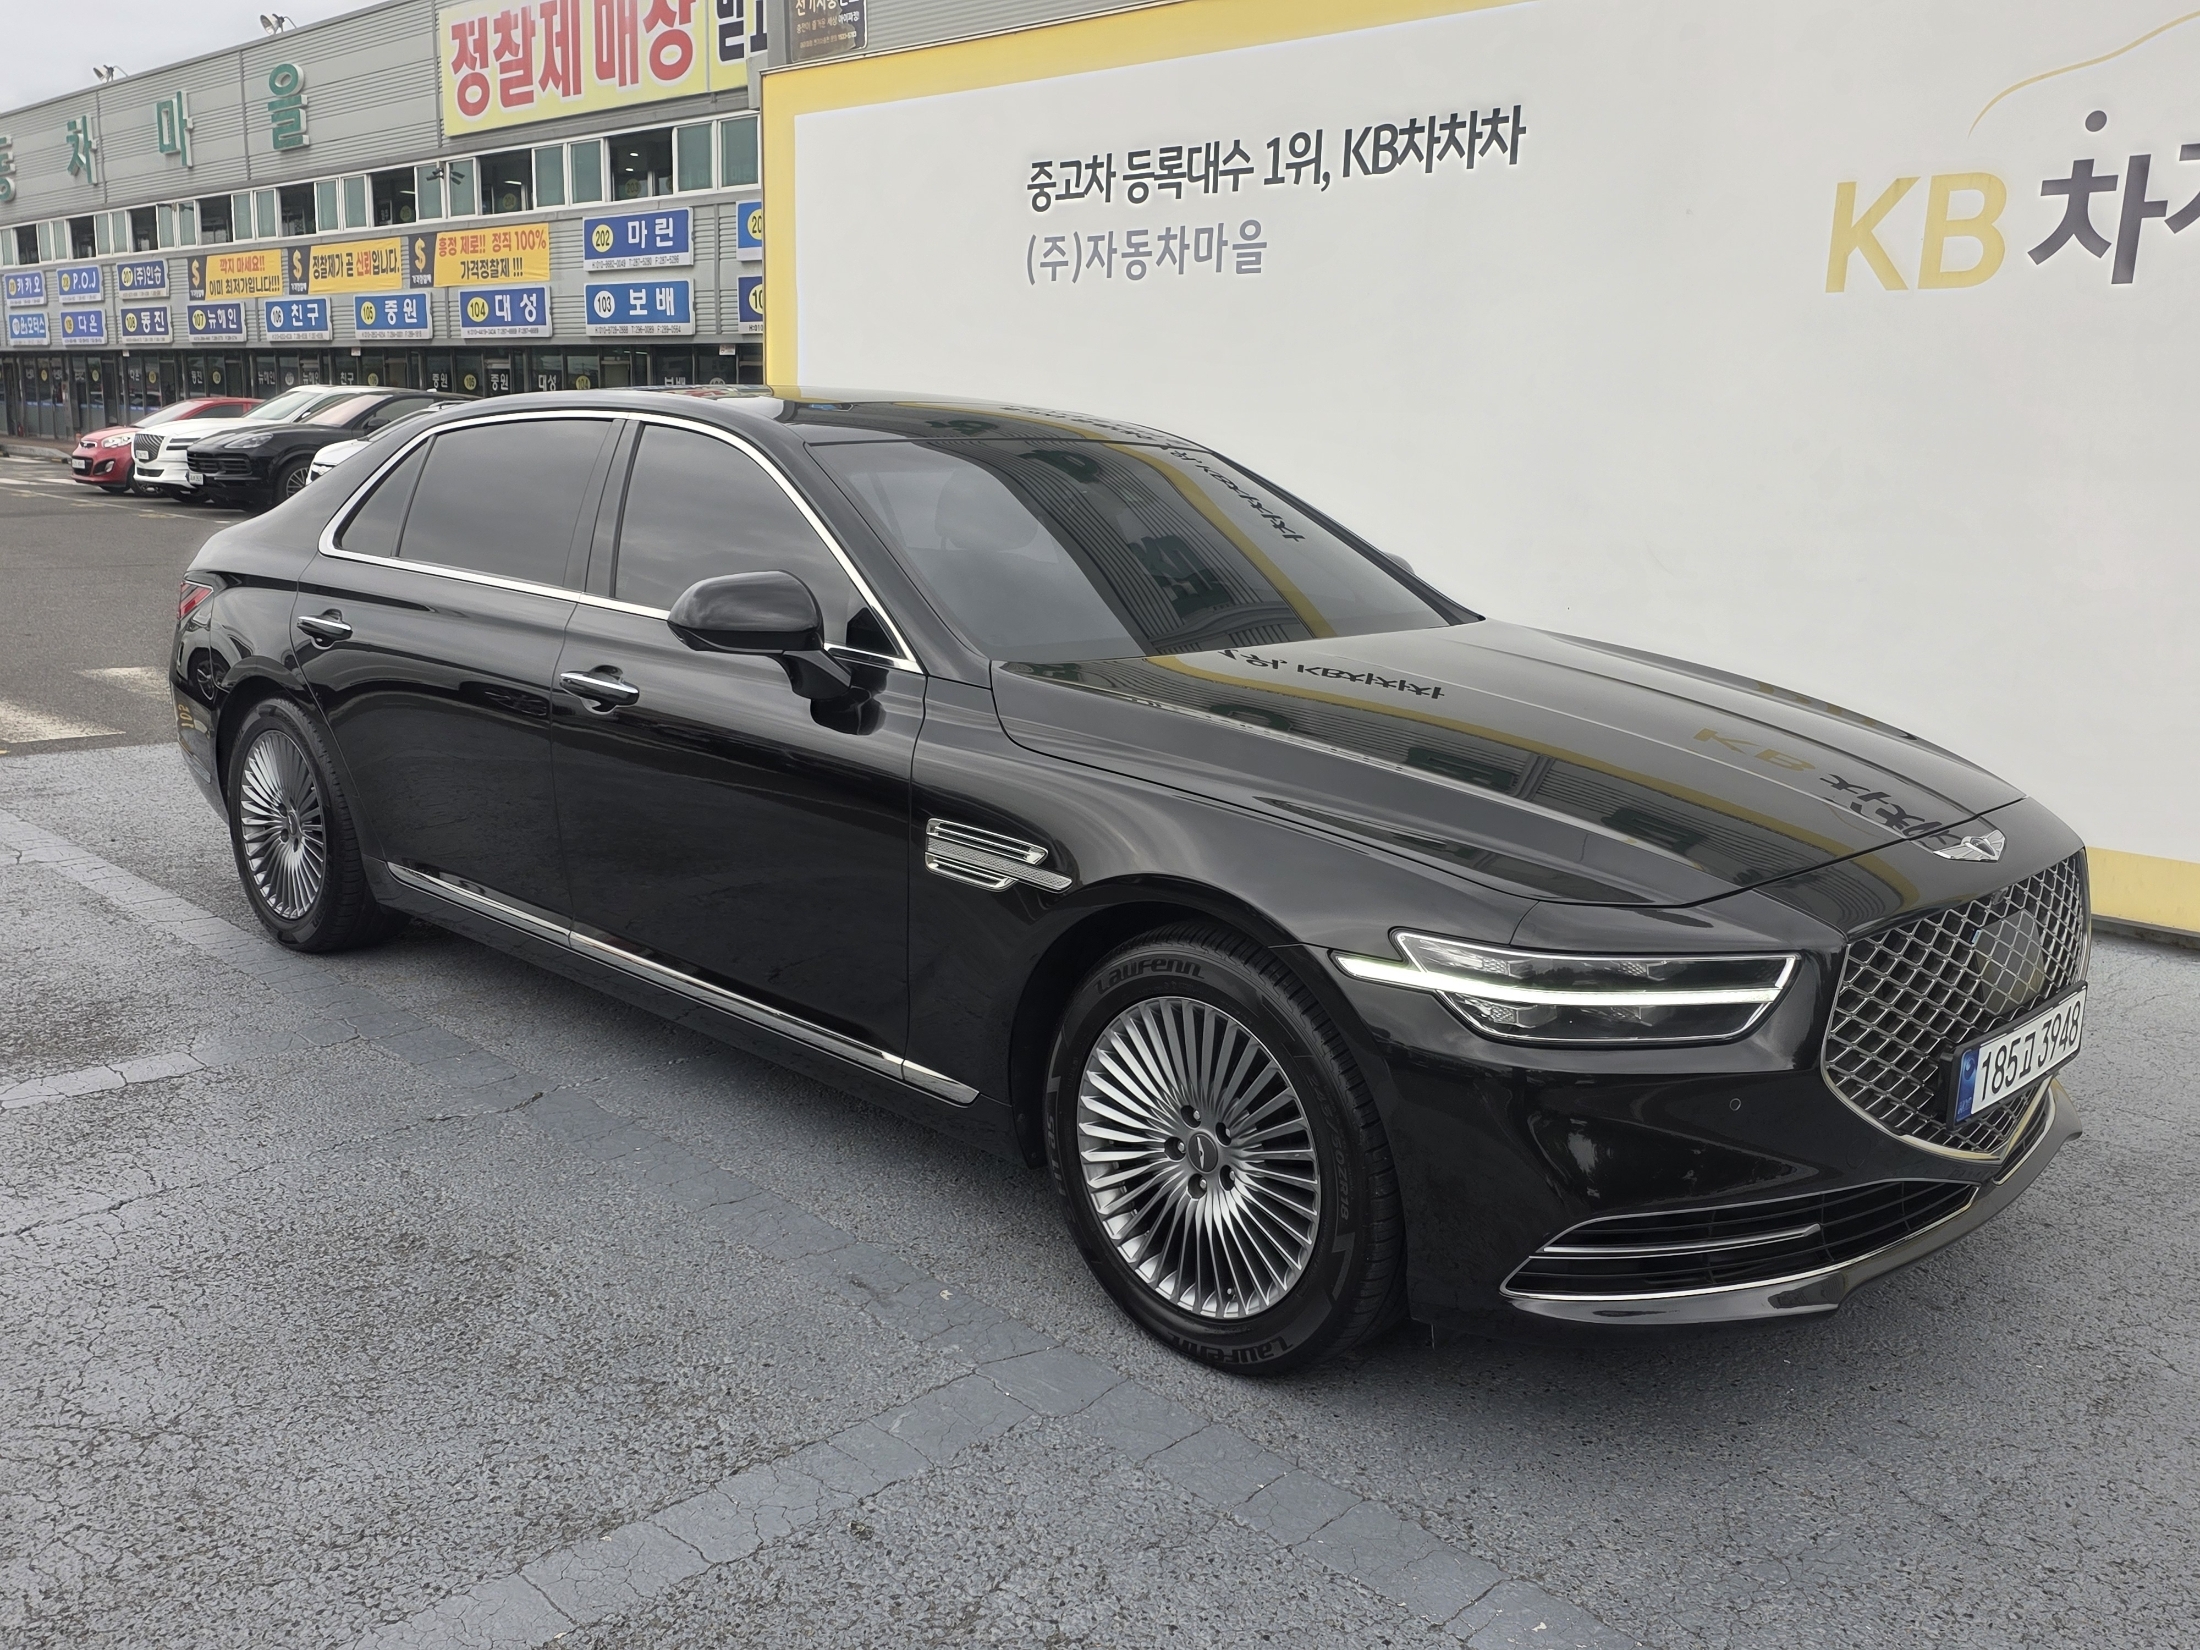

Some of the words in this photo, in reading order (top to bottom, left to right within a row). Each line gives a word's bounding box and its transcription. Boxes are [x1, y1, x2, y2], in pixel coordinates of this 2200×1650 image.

[451, 0, 583, 117] 정찰제
[1027, 153, 1117, 213] 중고차
[1122, 139, 1255, 205] 등록대수
[1263, 128, 1331, 192] 1위,
[1342, 104, 1527, 178] KB차차차
[438, 236, 457, 258] 흥정
[460, 234, 486, 254] 제로!!
[491, 231, 511, 253] 정직
[514, 229, 547, 251] 100%
[595, 230, 610, 247] 202
[627, 217, 674, 249] 마린
[236, 255, 266, 273] 마세요!!
[312, 253, 344, 280] 정찰제가
[356, 247, 400, 277] 신뢰입니다.
[1026, 219, 1268, 286] (주)자동차마을
[460, 257, 510, 280] 가격정찰제
[17, 276, 41, 294] 카카오
[209, 279, 223, 296] 이미
[225, 275, 280, 295] 최저가입니다!!!
[291, 303, 319, 327] 친구
[470, 301, 486, 318] 104
[494, 293, 537, 323] 대성
[597, 296, 612, 313] 103
[629, 287, 675, 316] 보배
[140, 310, 165, 333] 동진
[1981, 1031, 2036, 1102] 185고
[2037, 1000, 2081, 1068] 3948
